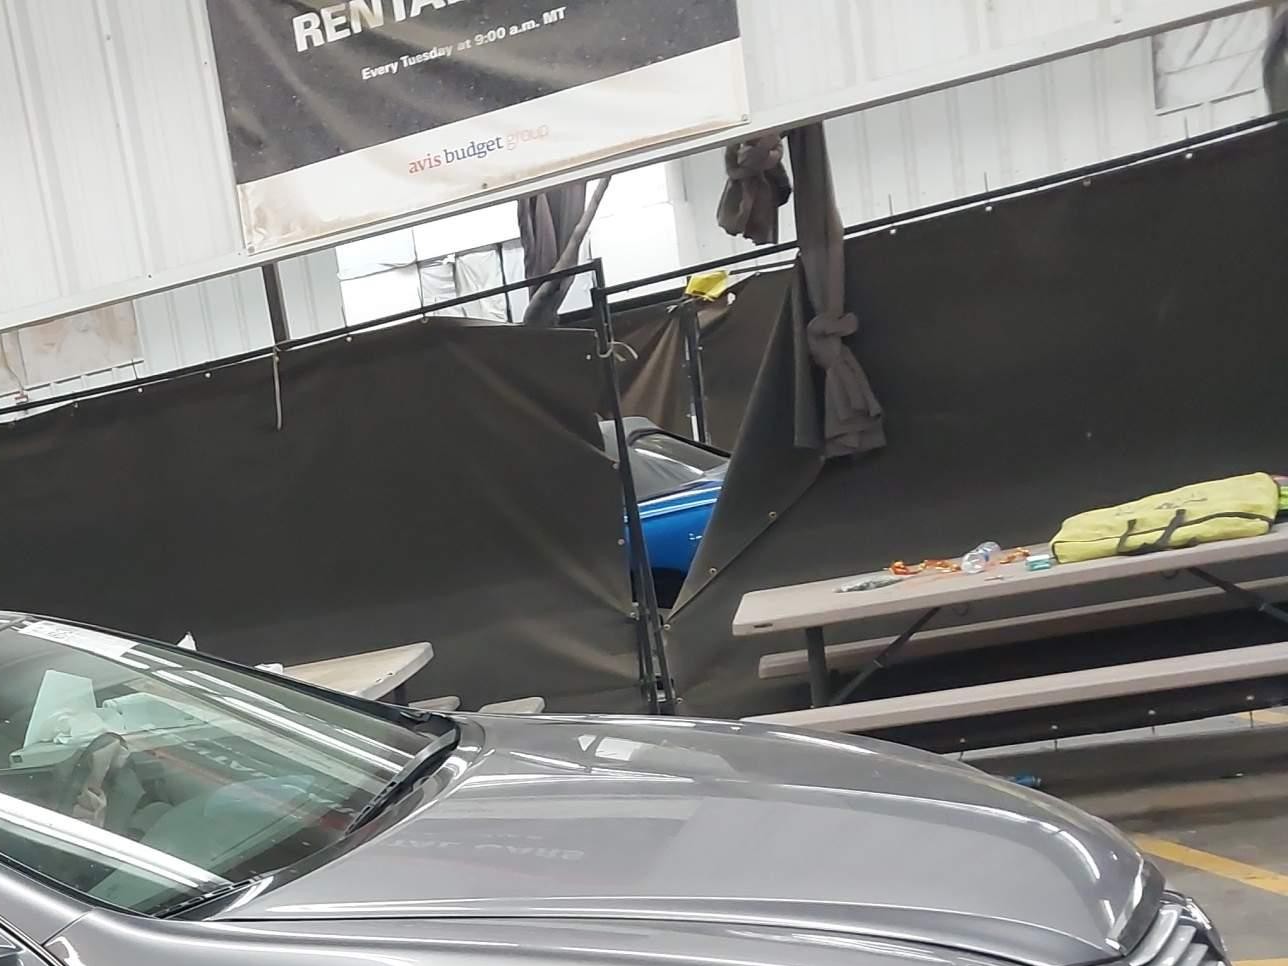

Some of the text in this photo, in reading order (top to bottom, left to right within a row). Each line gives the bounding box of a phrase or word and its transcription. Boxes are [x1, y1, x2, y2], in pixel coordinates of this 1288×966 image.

[292, 0, 469, 52] RENT
[361, 7, 567, 80] Every Tuesday at 9:00 a.m. MT
[408, 124, 549, 174] avis budget group
